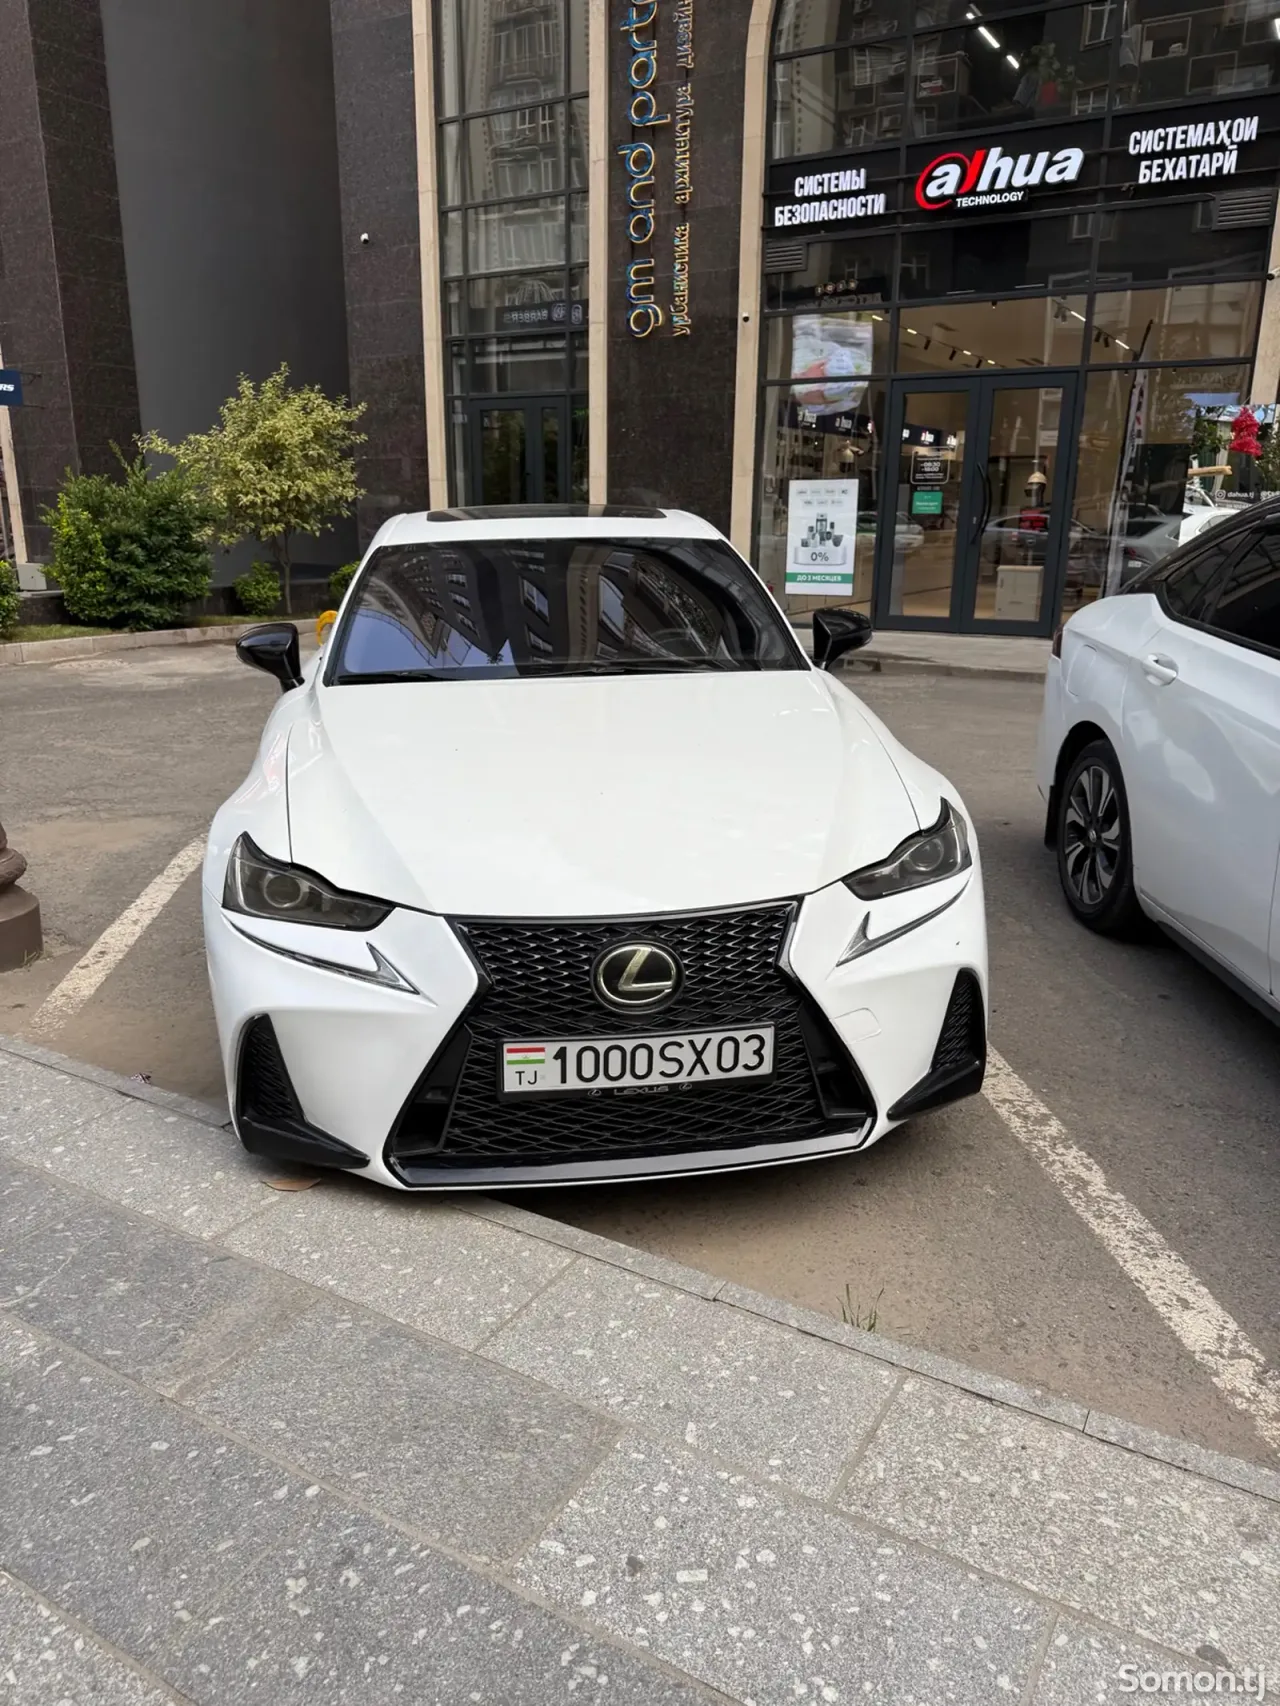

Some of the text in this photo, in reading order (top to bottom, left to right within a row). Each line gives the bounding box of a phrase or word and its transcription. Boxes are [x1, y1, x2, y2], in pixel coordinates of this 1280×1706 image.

[675, 83, 695, 204] архитектура
[617, 0, 671, 337] gm and part
[794, 168, 866, 198] СИСТЕМЫ
[774, 193, 886, 227] БЕЗОПАСНОСТИ
[956, 191, 1025, 208] TECHNOLOGY
[810, 551, 829, 562] 0%
[552, 1033, 766, 1084] 1000SX03
[515, 1070, 538, 1086] TJ
